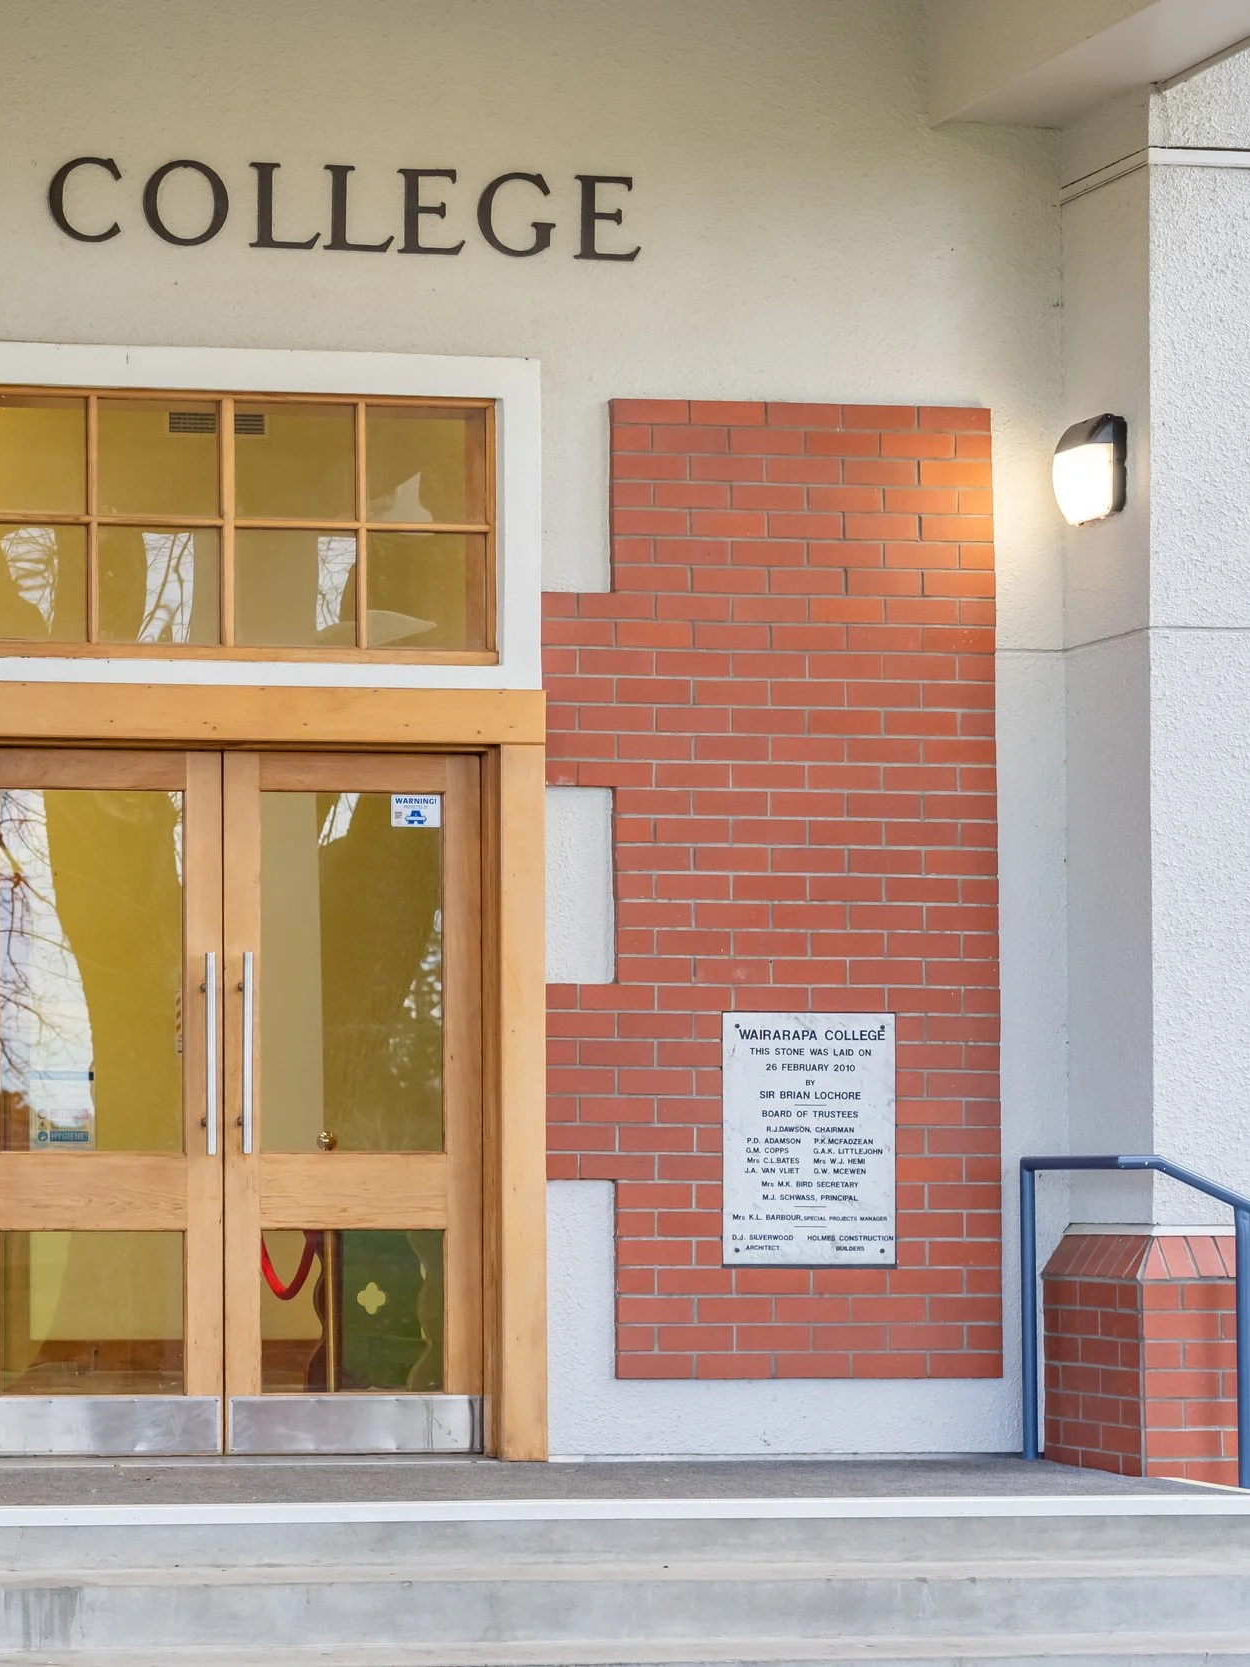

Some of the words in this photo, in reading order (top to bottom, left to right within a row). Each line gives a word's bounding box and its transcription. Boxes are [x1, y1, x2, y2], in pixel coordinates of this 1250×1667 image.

[49, 156, 642, 262] COLLEGE
[739, 1029, 817, 1041] WAIRARAPA
[824, 1030, 886, 1041] COLLEGE
[774, 1048, 805, 1056] STONE
[809, 1048, 829, 1056] WAS
[781, 1064, 829, 1072] FEBRUARY
[833, 1064, 856, 1072] 2010
[759, 1091, 775, 1099] SIR
[780, 1091, 810, 1099] BRIAN
[814, 1092, 862, 1100] LOCHORE
[762, 1110, 792, 1118] BOARD
[796, 1110, 808, 1118] OF
[813, 1110, 859, 1118] TRUSTEES
